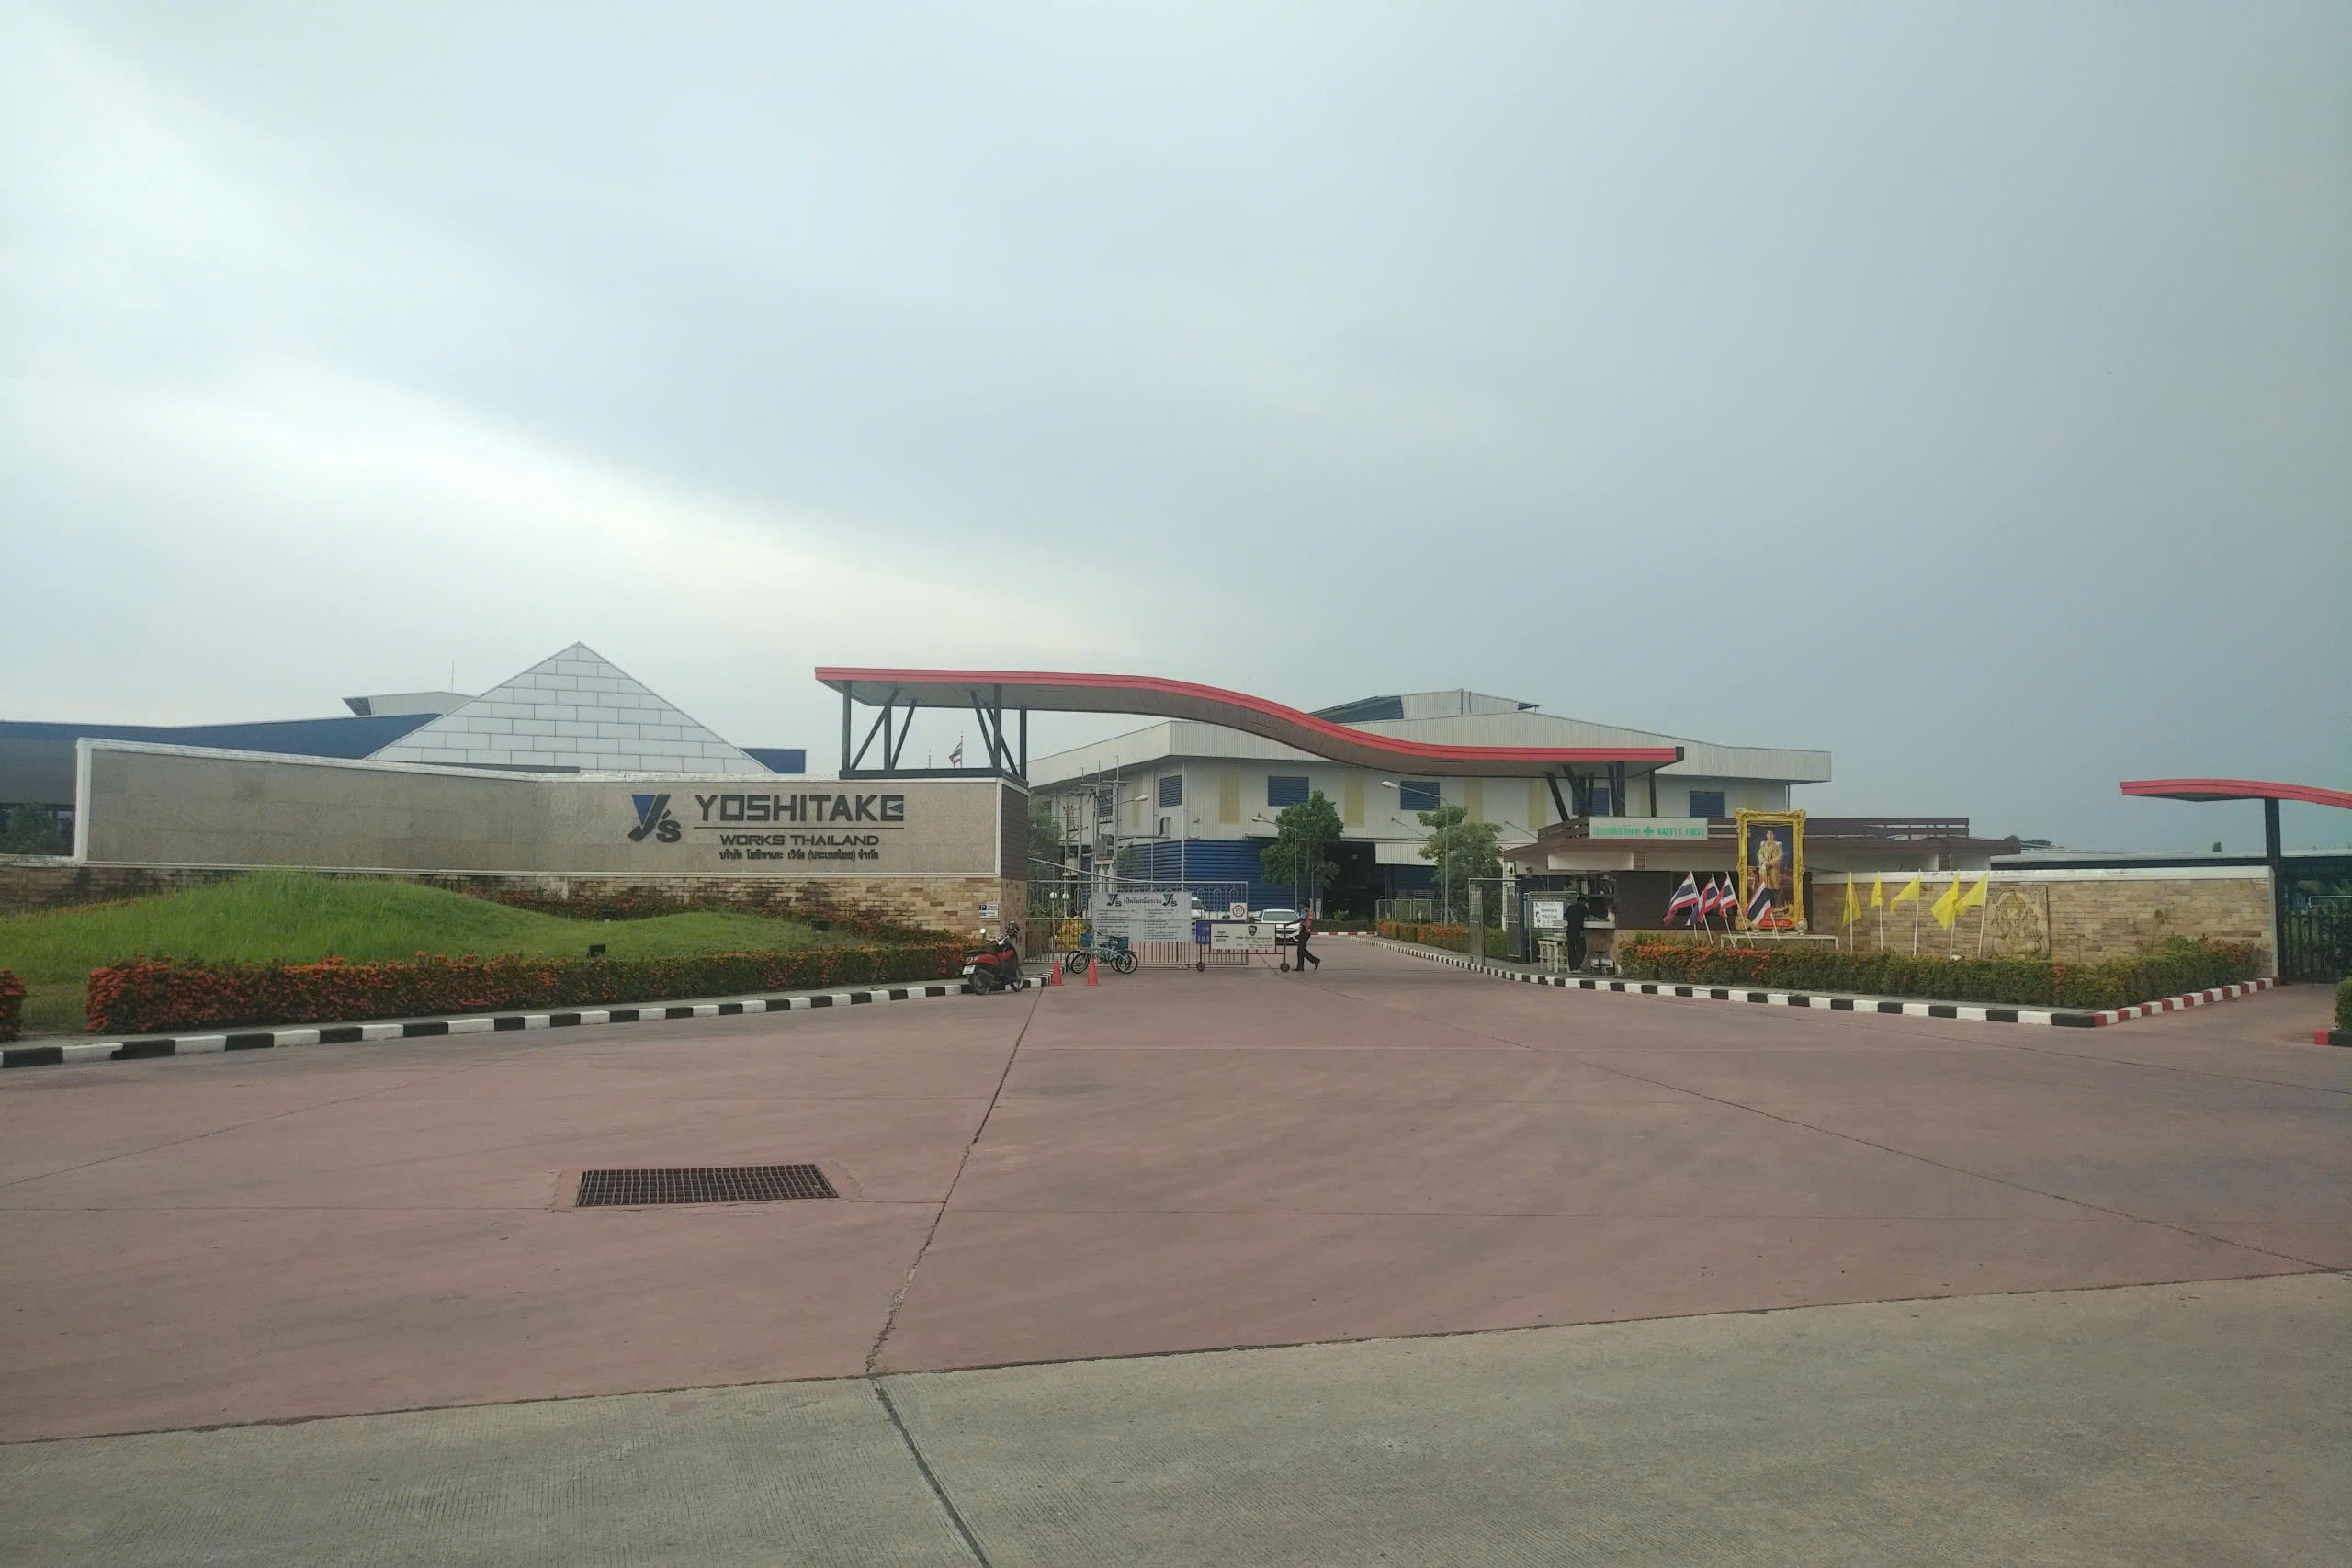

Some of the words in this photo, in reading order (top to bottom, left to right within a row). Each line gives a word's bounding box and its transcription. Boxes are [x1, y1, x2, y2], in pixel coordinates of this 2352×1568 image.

[695, 794, 905, 822] YOSHITAKE
[719, 834, 786, 846] WORKS
[790, 834, 880, 846] THAILAND
